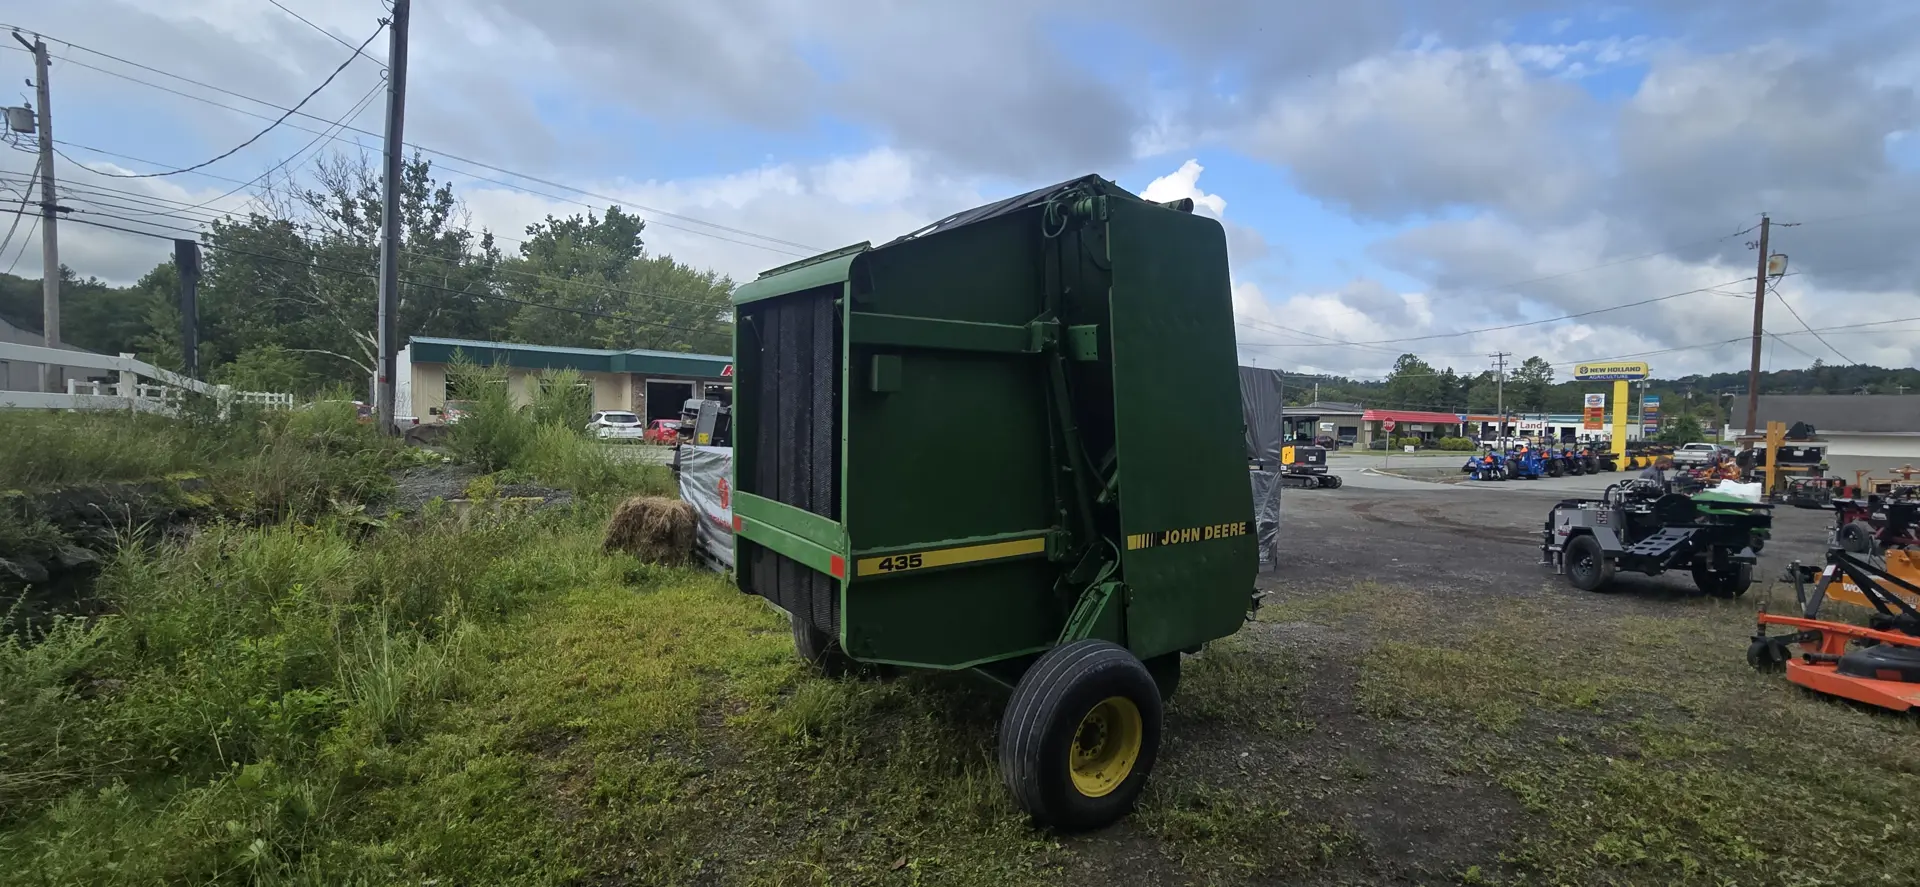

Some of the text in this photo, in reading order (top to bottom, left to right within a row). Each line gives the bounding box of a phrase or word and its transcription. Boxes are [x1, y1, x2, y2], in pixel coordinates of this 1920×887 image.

[1520, 421, 1542, 429] Land
[1160, 521, 1246, 546] JOHN DEERE
[878, 553, 922, 571] 435
